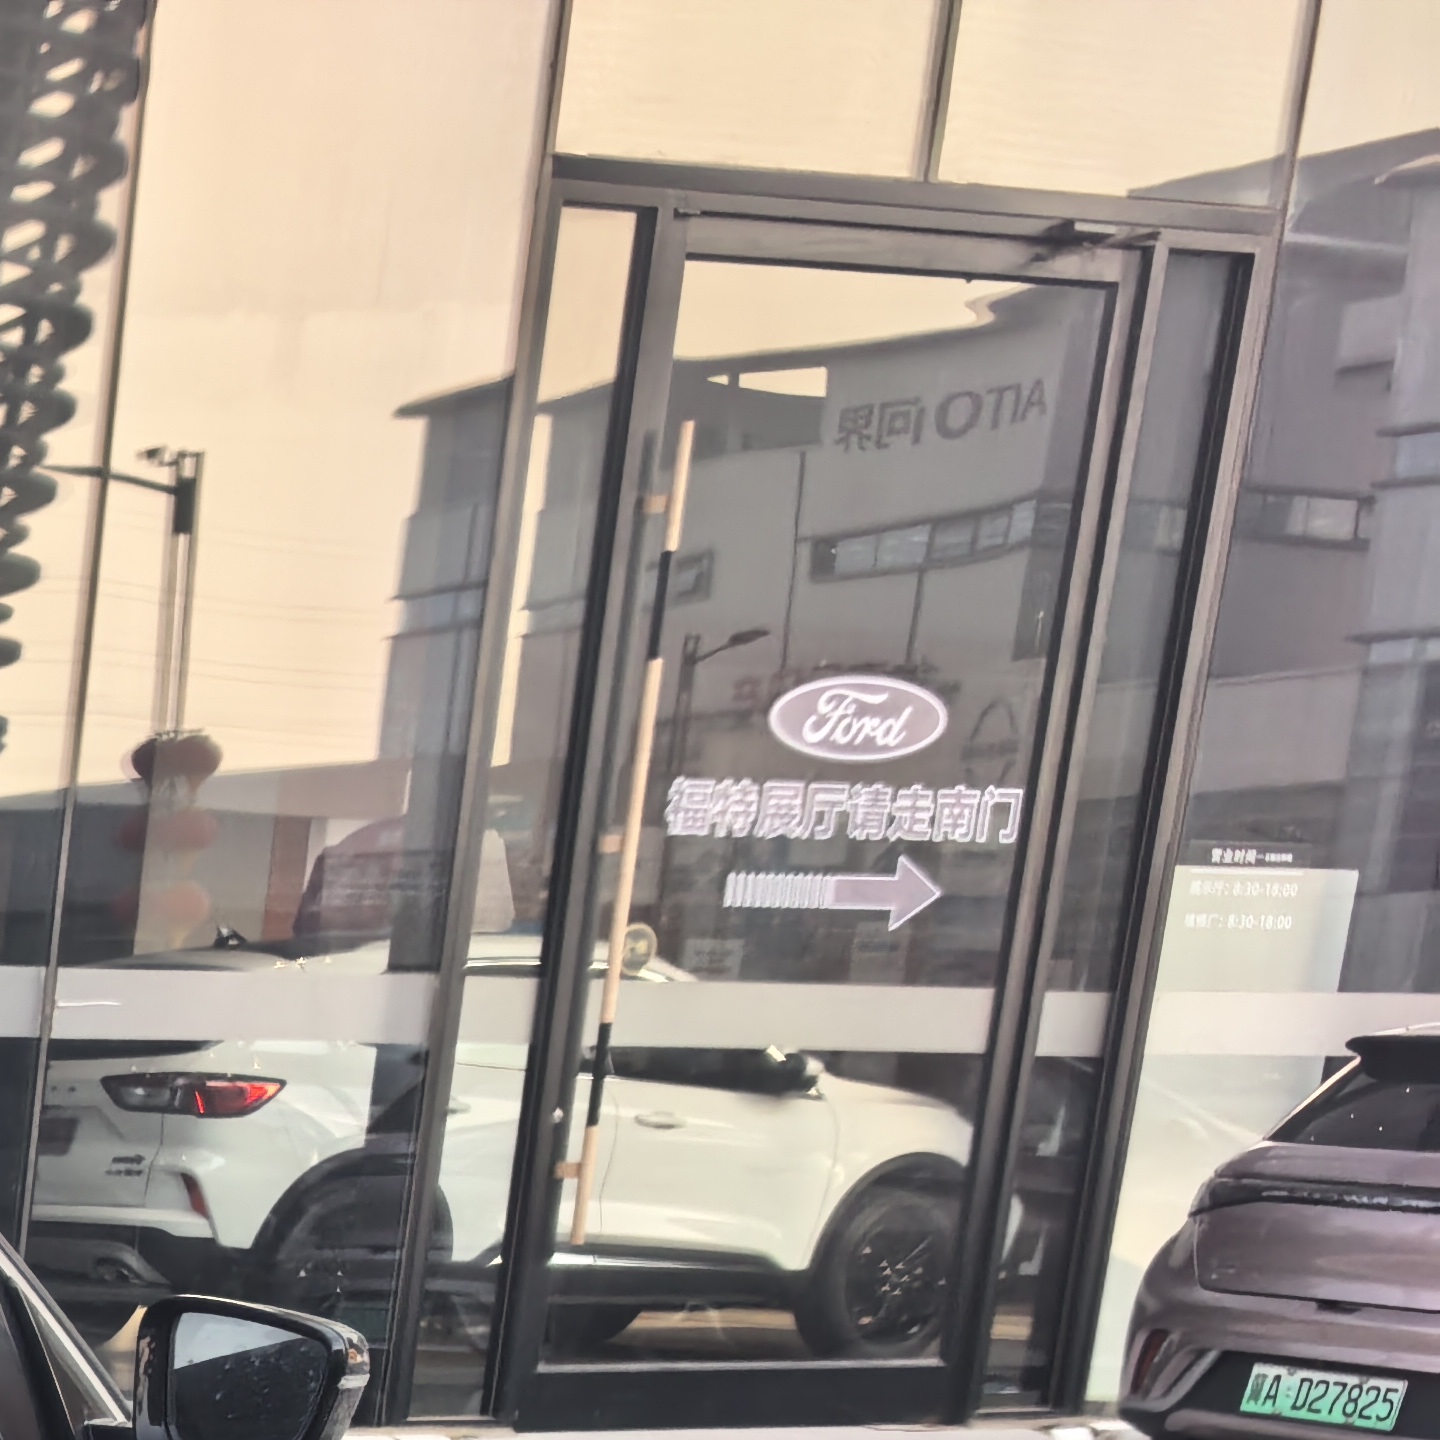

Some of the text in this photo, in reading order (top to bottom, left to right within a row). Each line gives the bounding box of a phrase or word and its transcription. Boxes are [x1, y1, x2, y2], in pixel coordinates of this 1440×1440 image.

[802, 688, 914, 747] Ford
[664, 774, 1024, 843] 福特展厅请走南门
[1290, 1377, 1400, 1423] D27825
